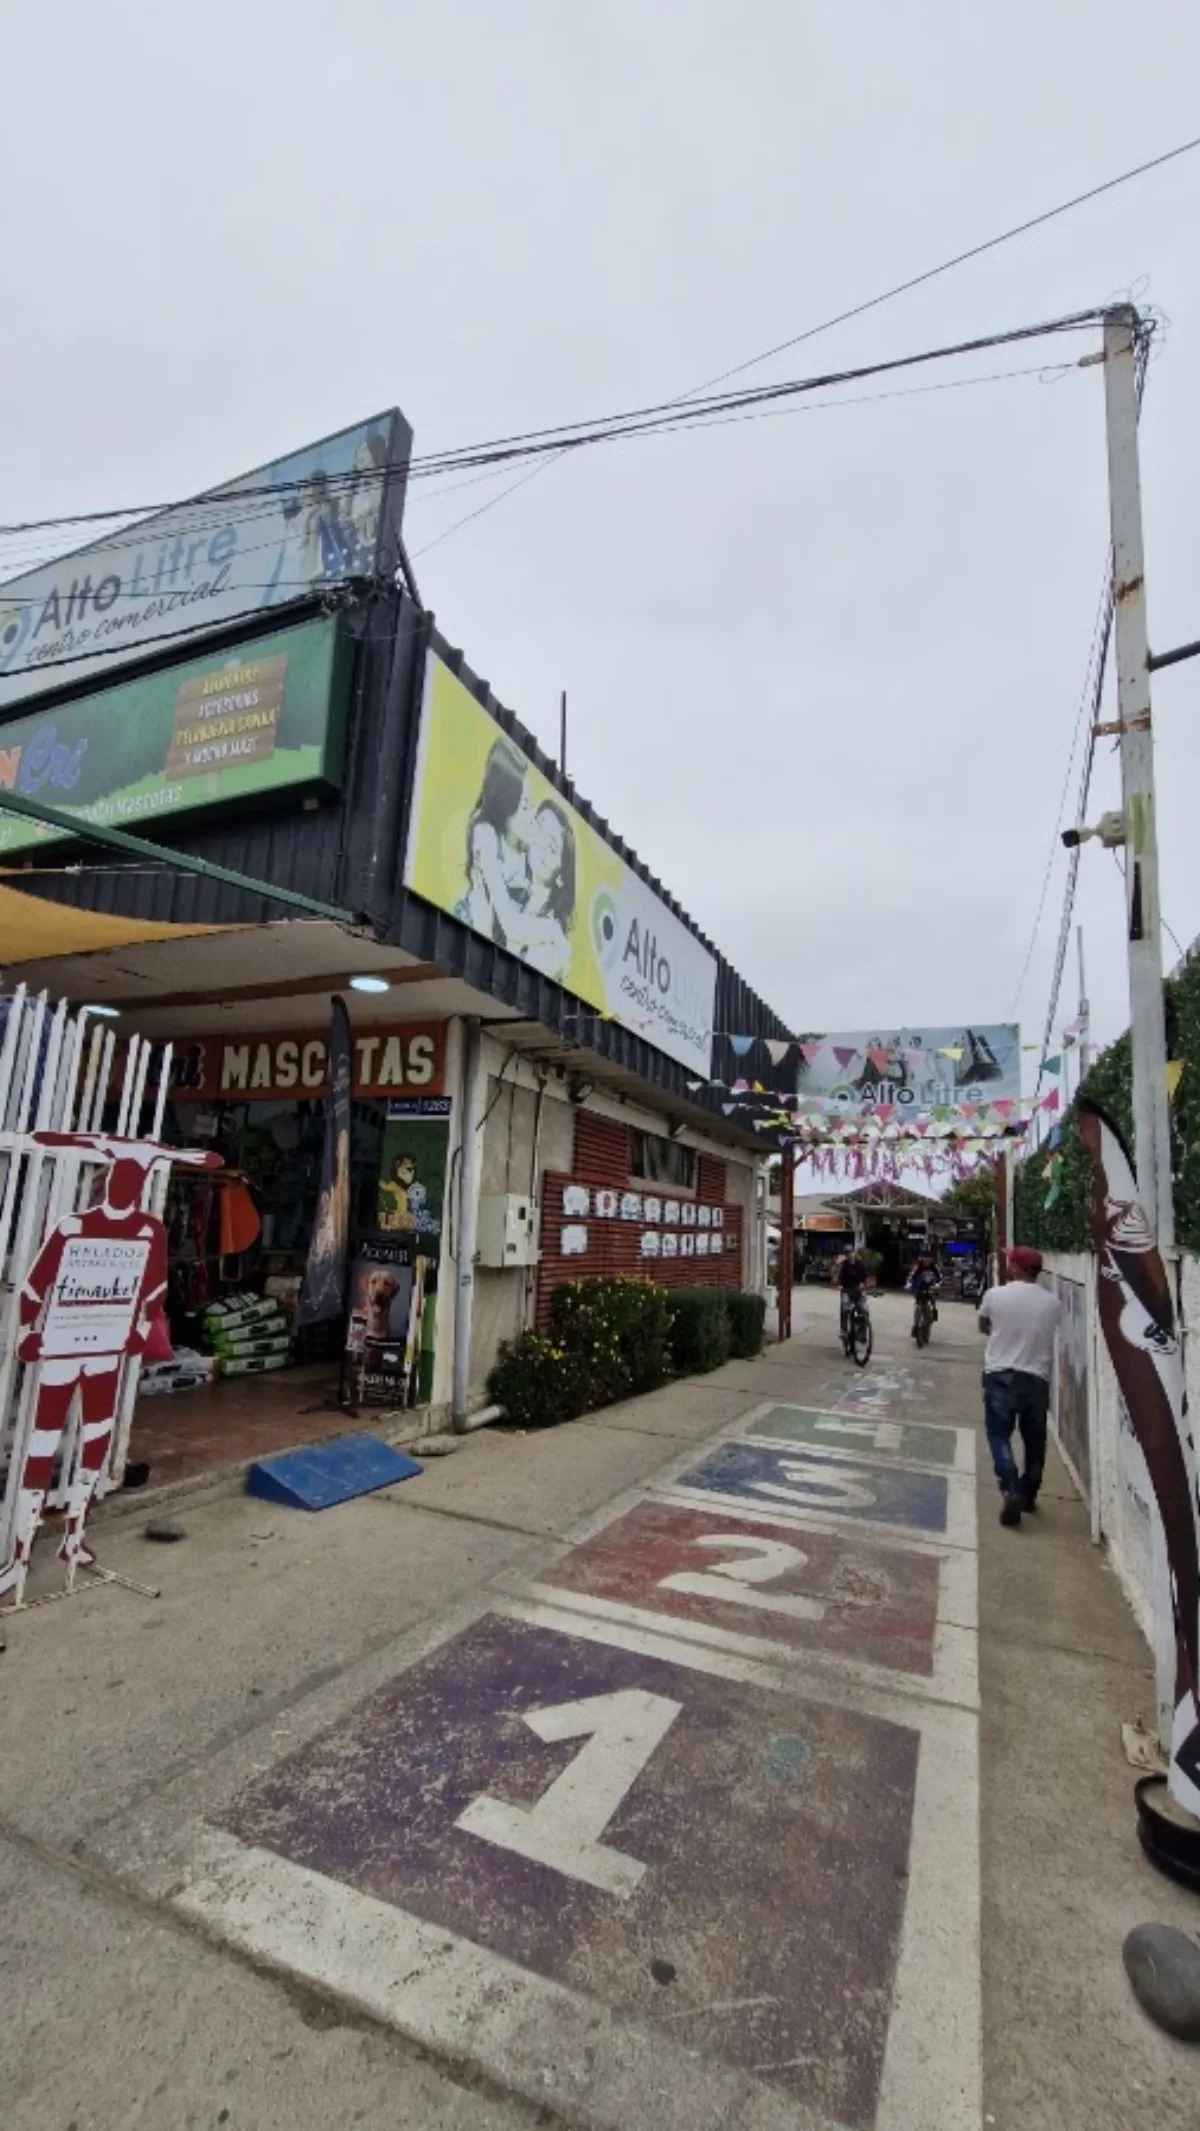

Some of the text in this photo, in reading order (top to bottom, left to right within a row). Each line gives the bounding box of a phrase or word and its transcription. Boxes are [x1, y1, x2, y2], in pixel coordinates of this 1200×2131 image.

[32, 527, 238, 638] Alto Litre
[94, 563, 233, 637] comercial
[622, 917, 671, 994] Alto
[220, 1034, 436, 1090] MASCTAS
[861, 1081, 984, 1105] Alto Litre
[748, 1458, 878, 1508] 3
[656, 1533, 826, 1620] 2
[453, 1688, 684, 1900] 1
